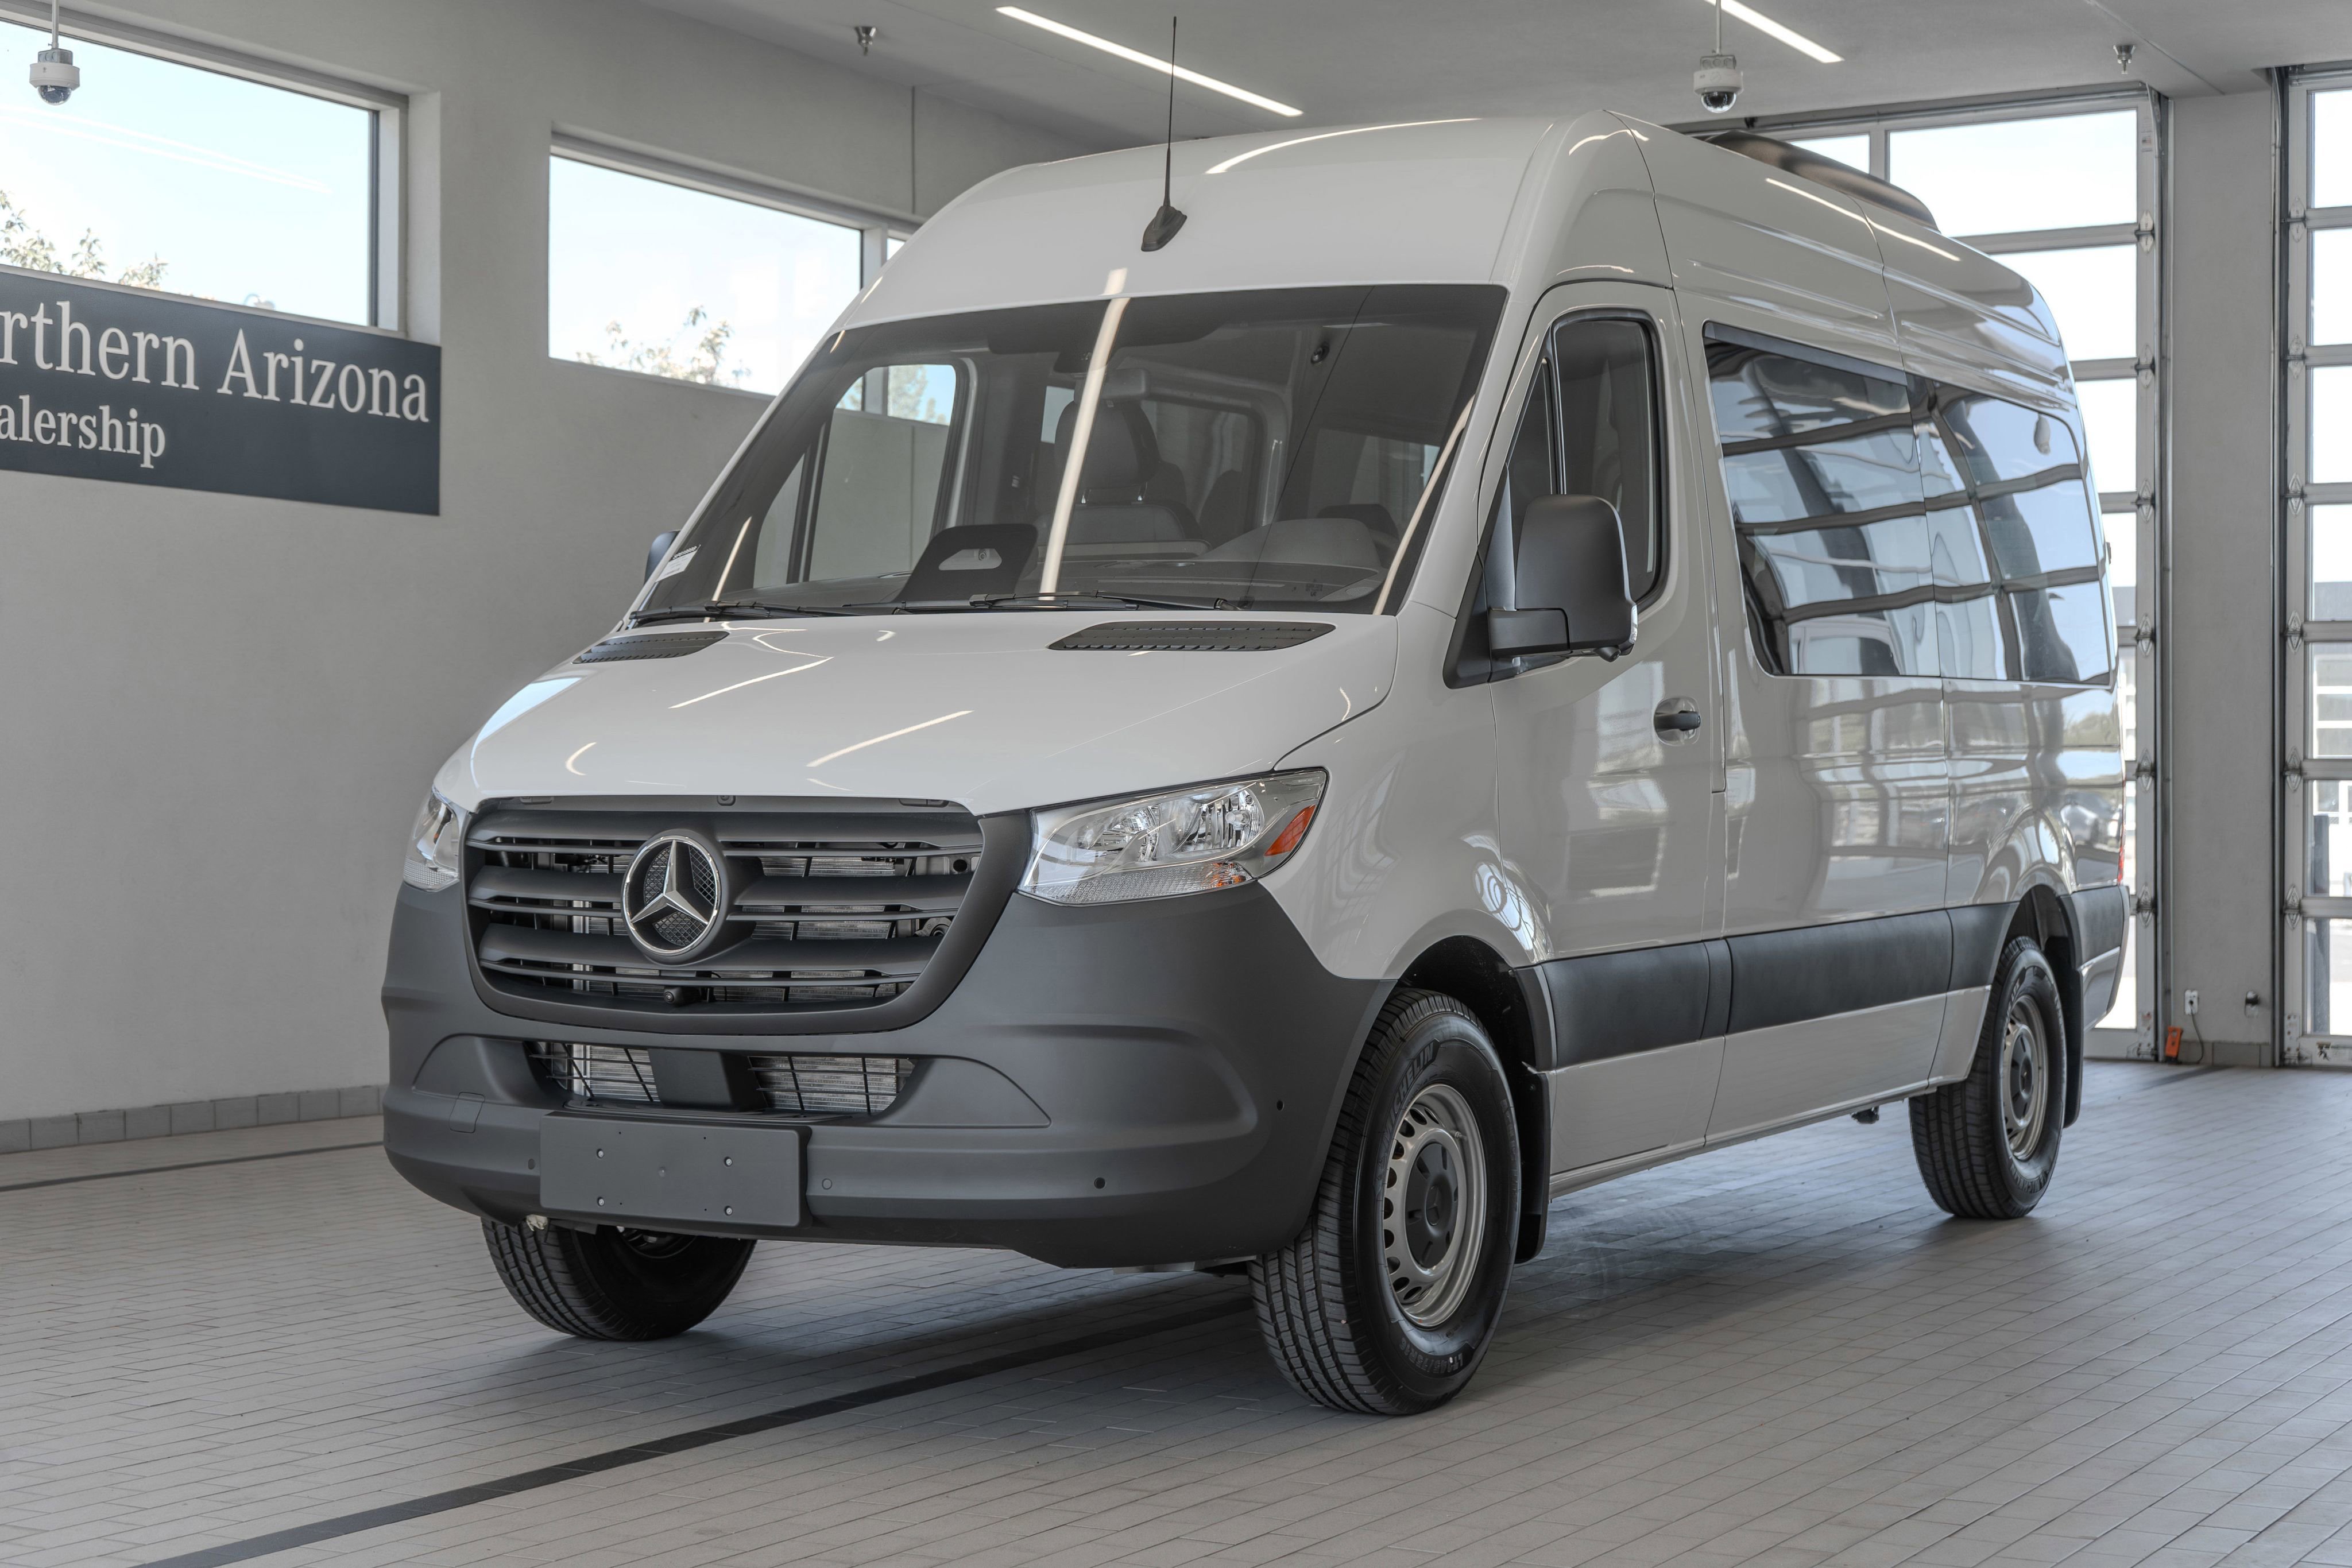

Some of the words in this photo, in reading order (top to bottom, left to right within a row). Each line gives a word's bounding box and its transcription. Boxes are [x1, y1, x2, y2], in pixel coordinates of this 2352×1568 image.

[0, 300, 199, 390] rthern
[216, 328, 430, 423] Arizona
[0, 394, 166, 469] alership
[1380, 1041, 1434, 1149] MICHELIN
